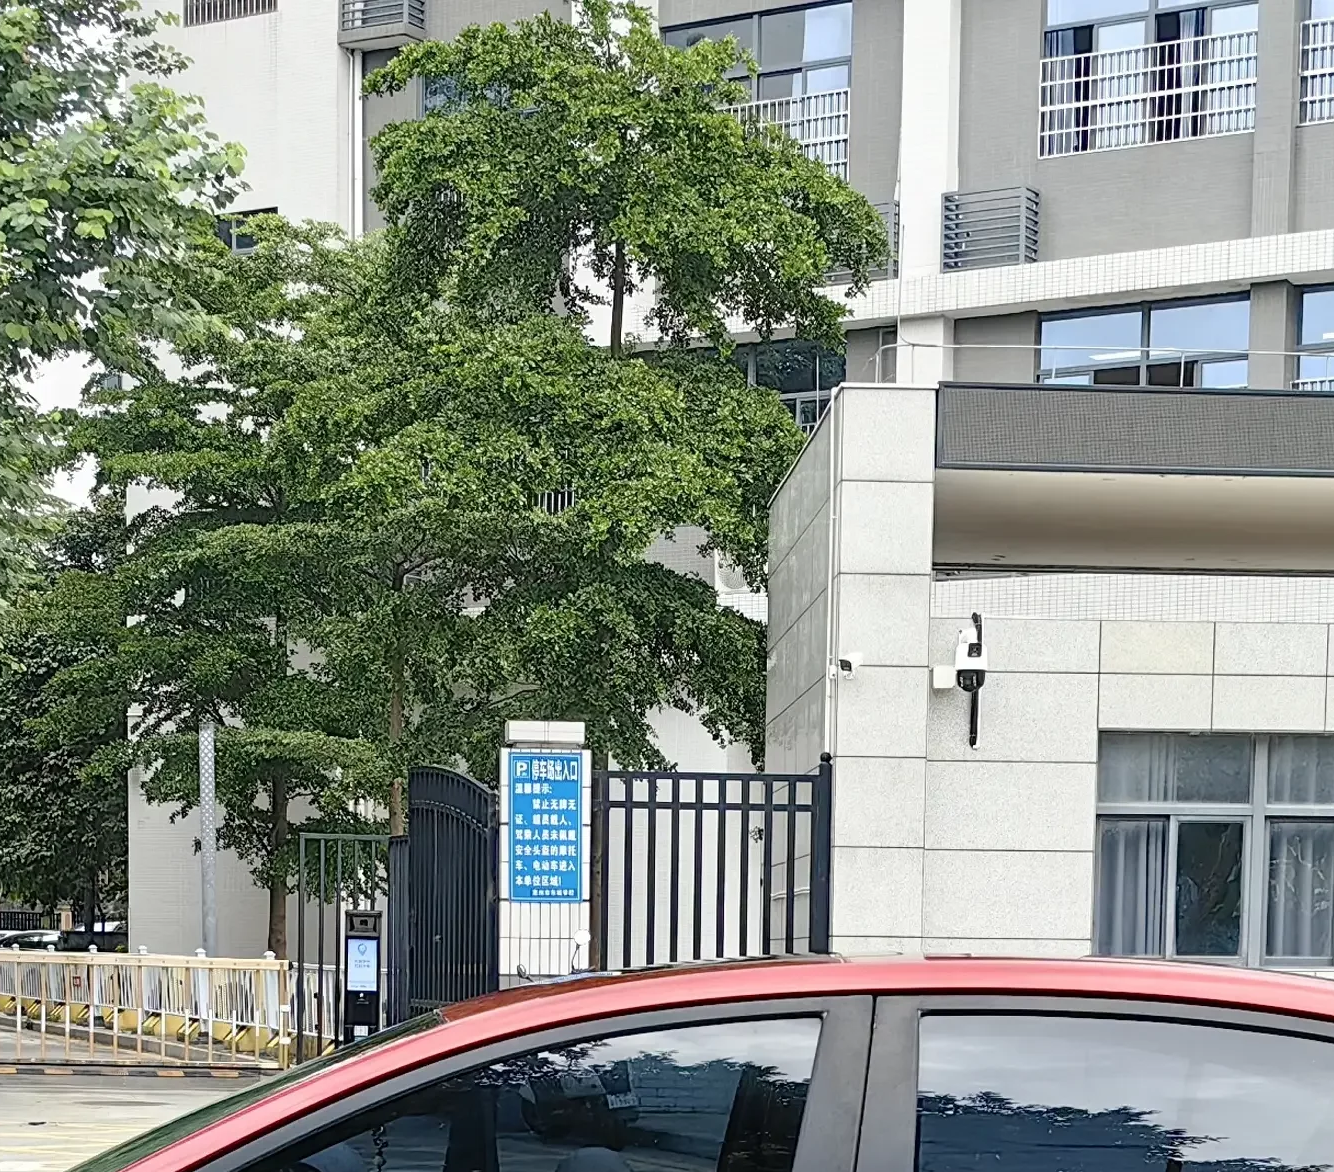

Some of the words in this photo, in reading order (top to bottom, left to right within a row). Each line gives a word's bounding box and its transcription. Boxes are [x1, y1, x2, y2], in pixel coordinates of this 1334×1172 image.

[531, 759, 578, 781] 停车场出入口
[532, 798, 577, 810] 禁止无牌无
[515, 845, 577, 857] 安全头盔的摩托
